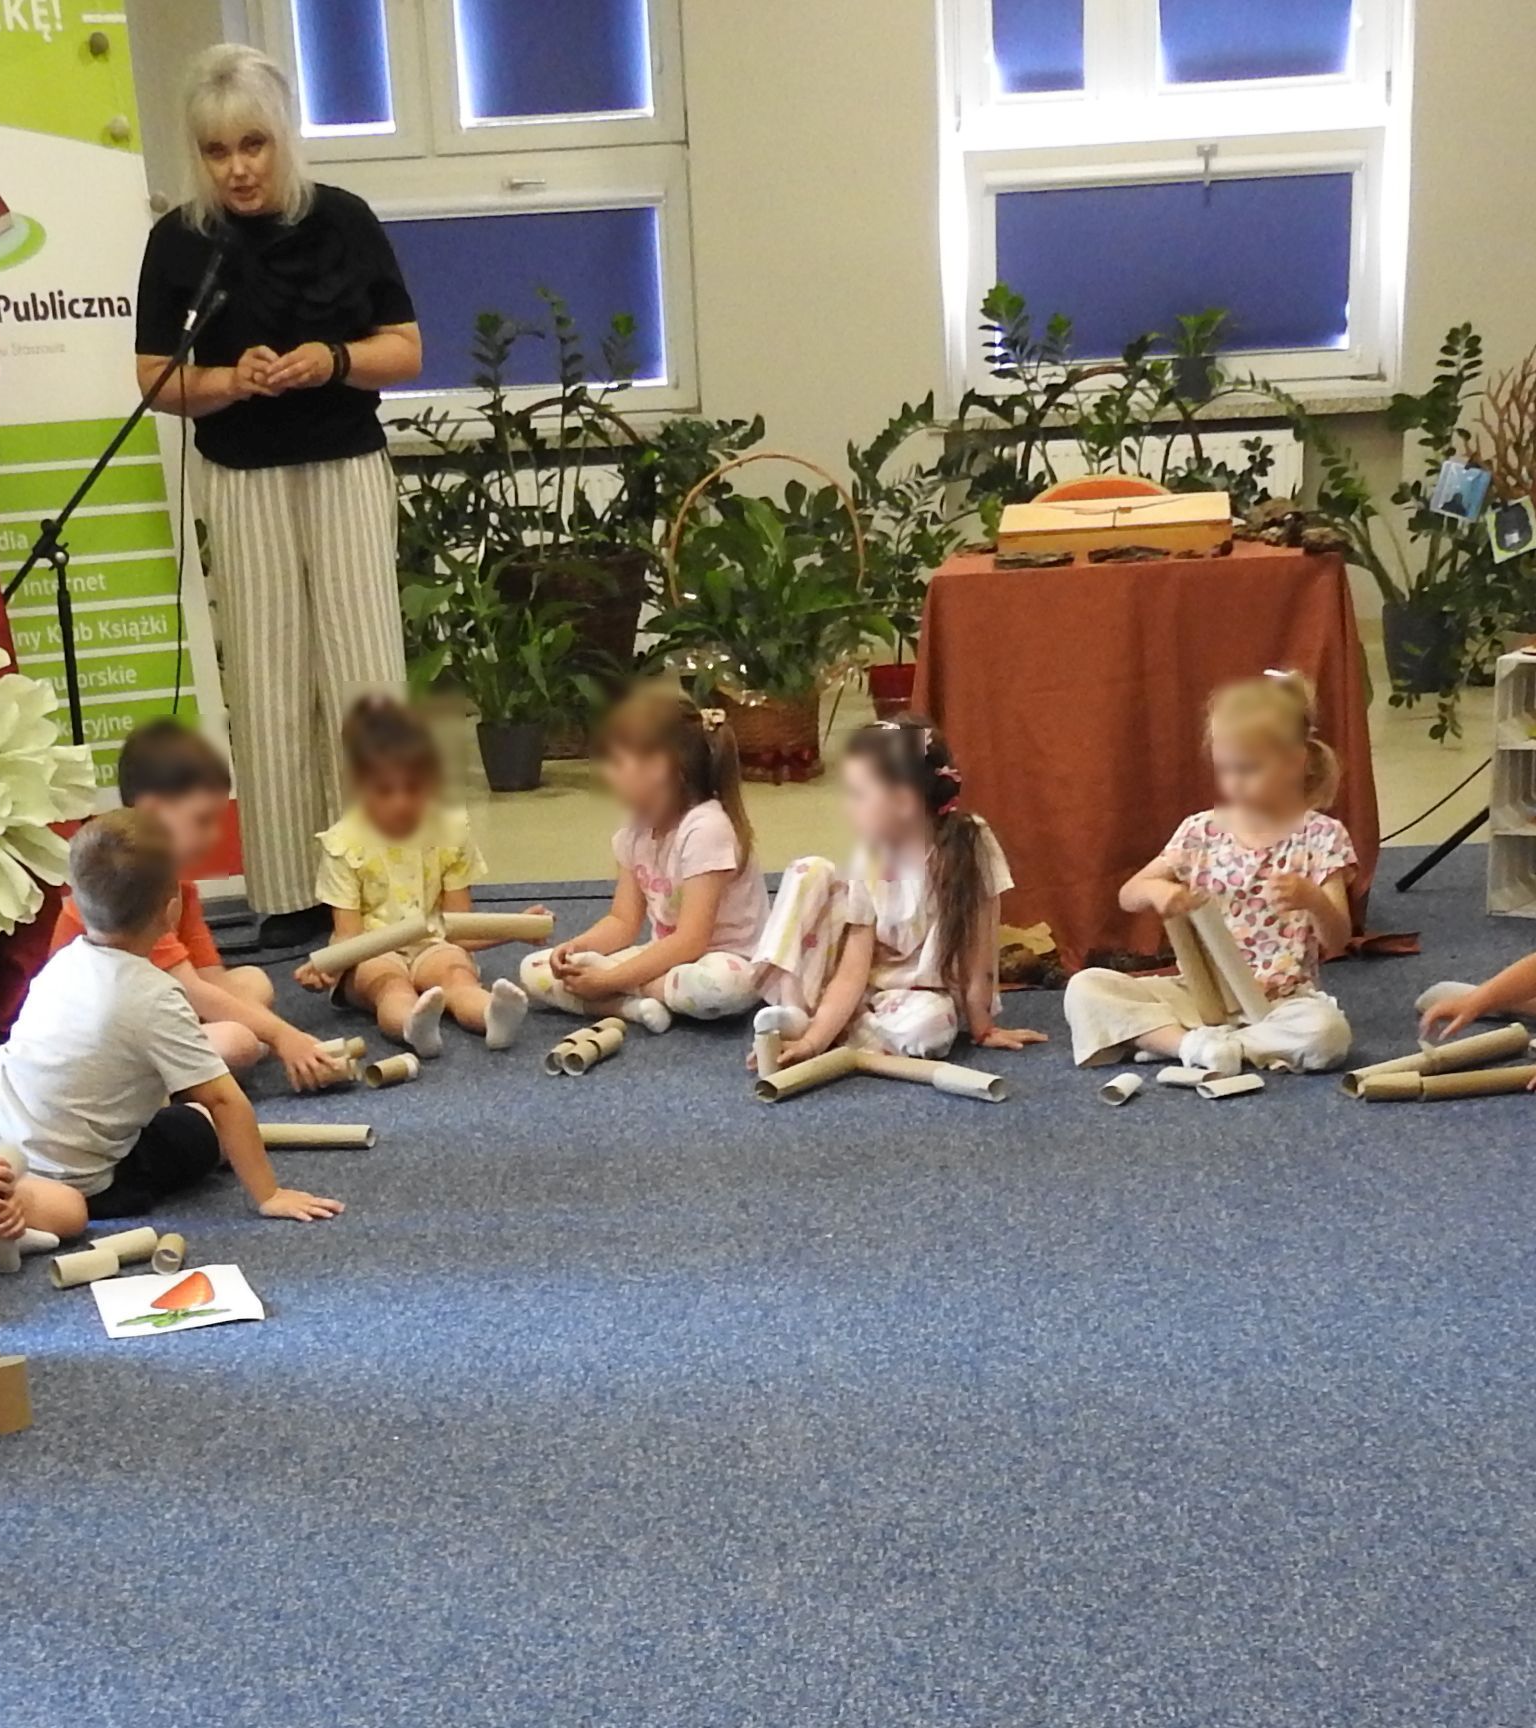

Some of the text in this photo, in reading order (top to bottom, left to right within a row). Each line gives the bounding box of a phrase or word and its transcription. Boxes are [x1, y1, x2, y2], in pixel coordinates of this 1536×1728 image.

[46, 621, 94, 644] Kub
[97, 614, 168, 642] Książki
[53, 665, 137, 691] uorskie
[56, 713, 135, 739] kcyjne
